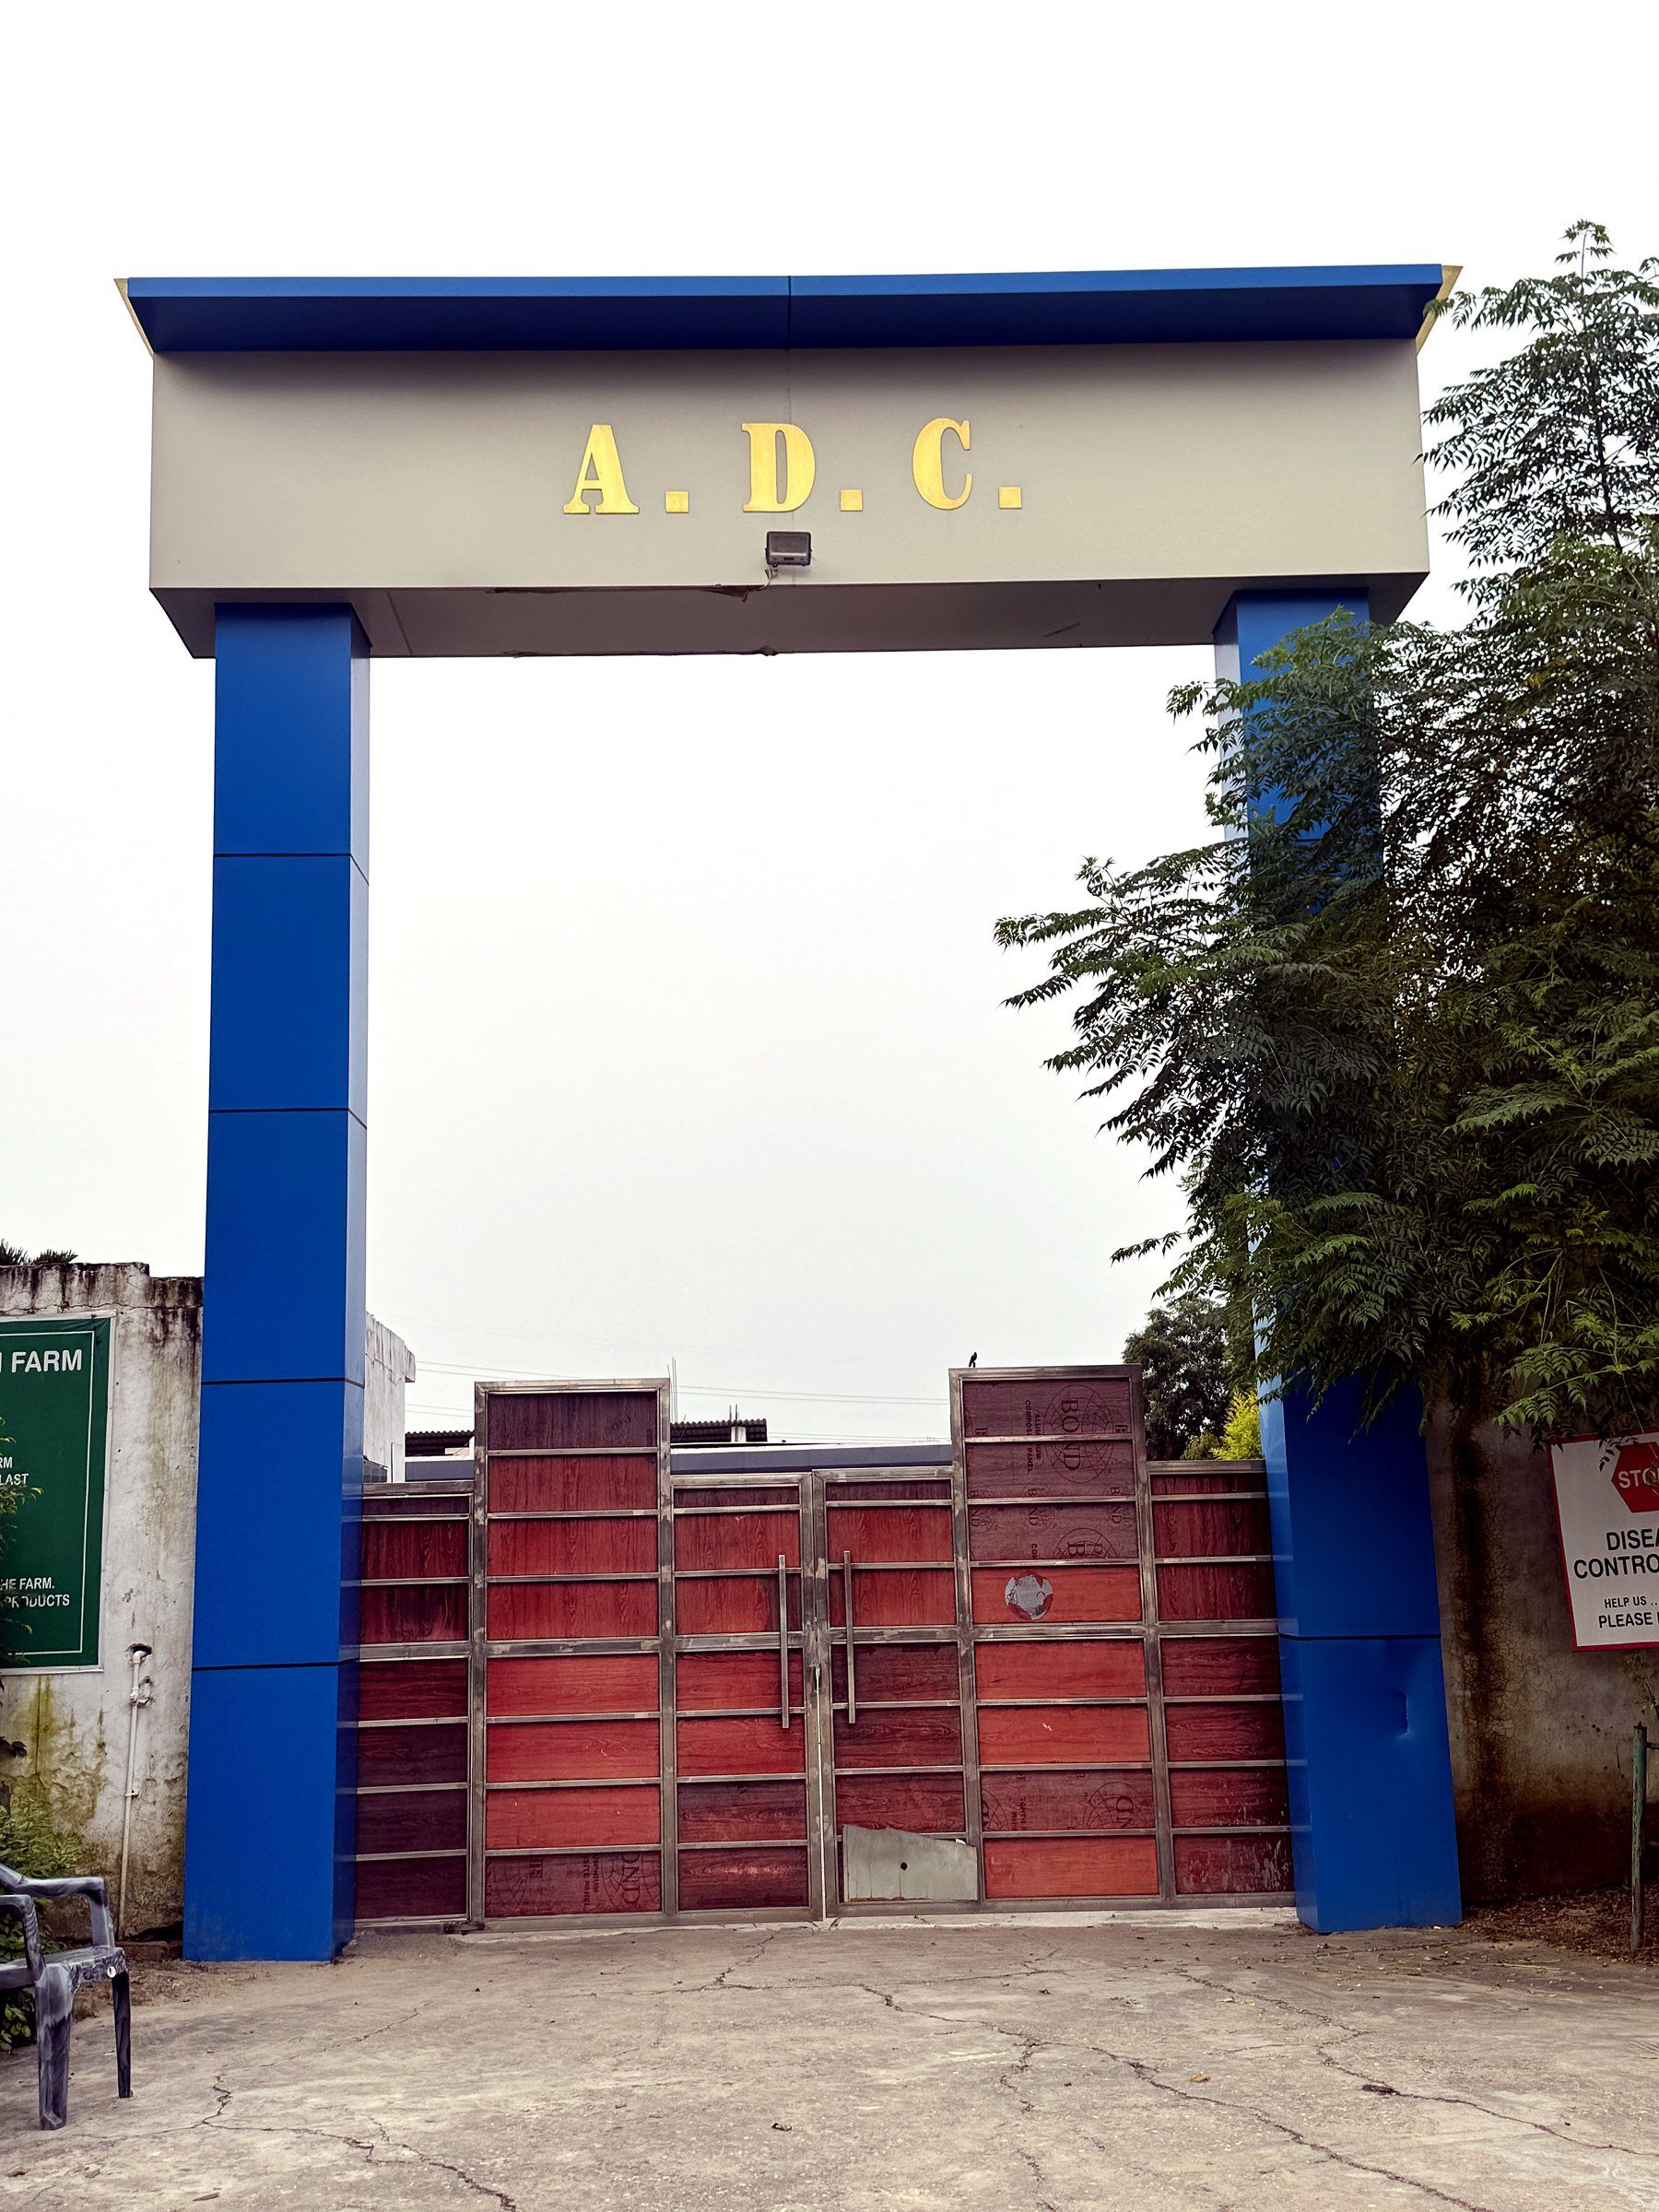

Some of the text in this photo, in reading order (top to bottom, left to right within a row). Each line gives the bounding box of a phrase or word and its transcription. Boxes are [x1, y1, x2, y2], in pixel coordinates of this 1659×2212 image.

[11, 1348, 82, 1373] FARM
[1618, 1468, 1659, 1488] STO
[1028, 1488, 1039, 1526] BND
[1111, 1487, 1123, 1524] BND
[1573, 1553, 1659, 1579] CONTRO
[19, 1577, 55, 1590] FARM.
[1604, 1596, 1630, 1608] HELP
[1632, 1595, 1647, 1606] US
[1598, 1611, 1653, 1629] PLEASE
